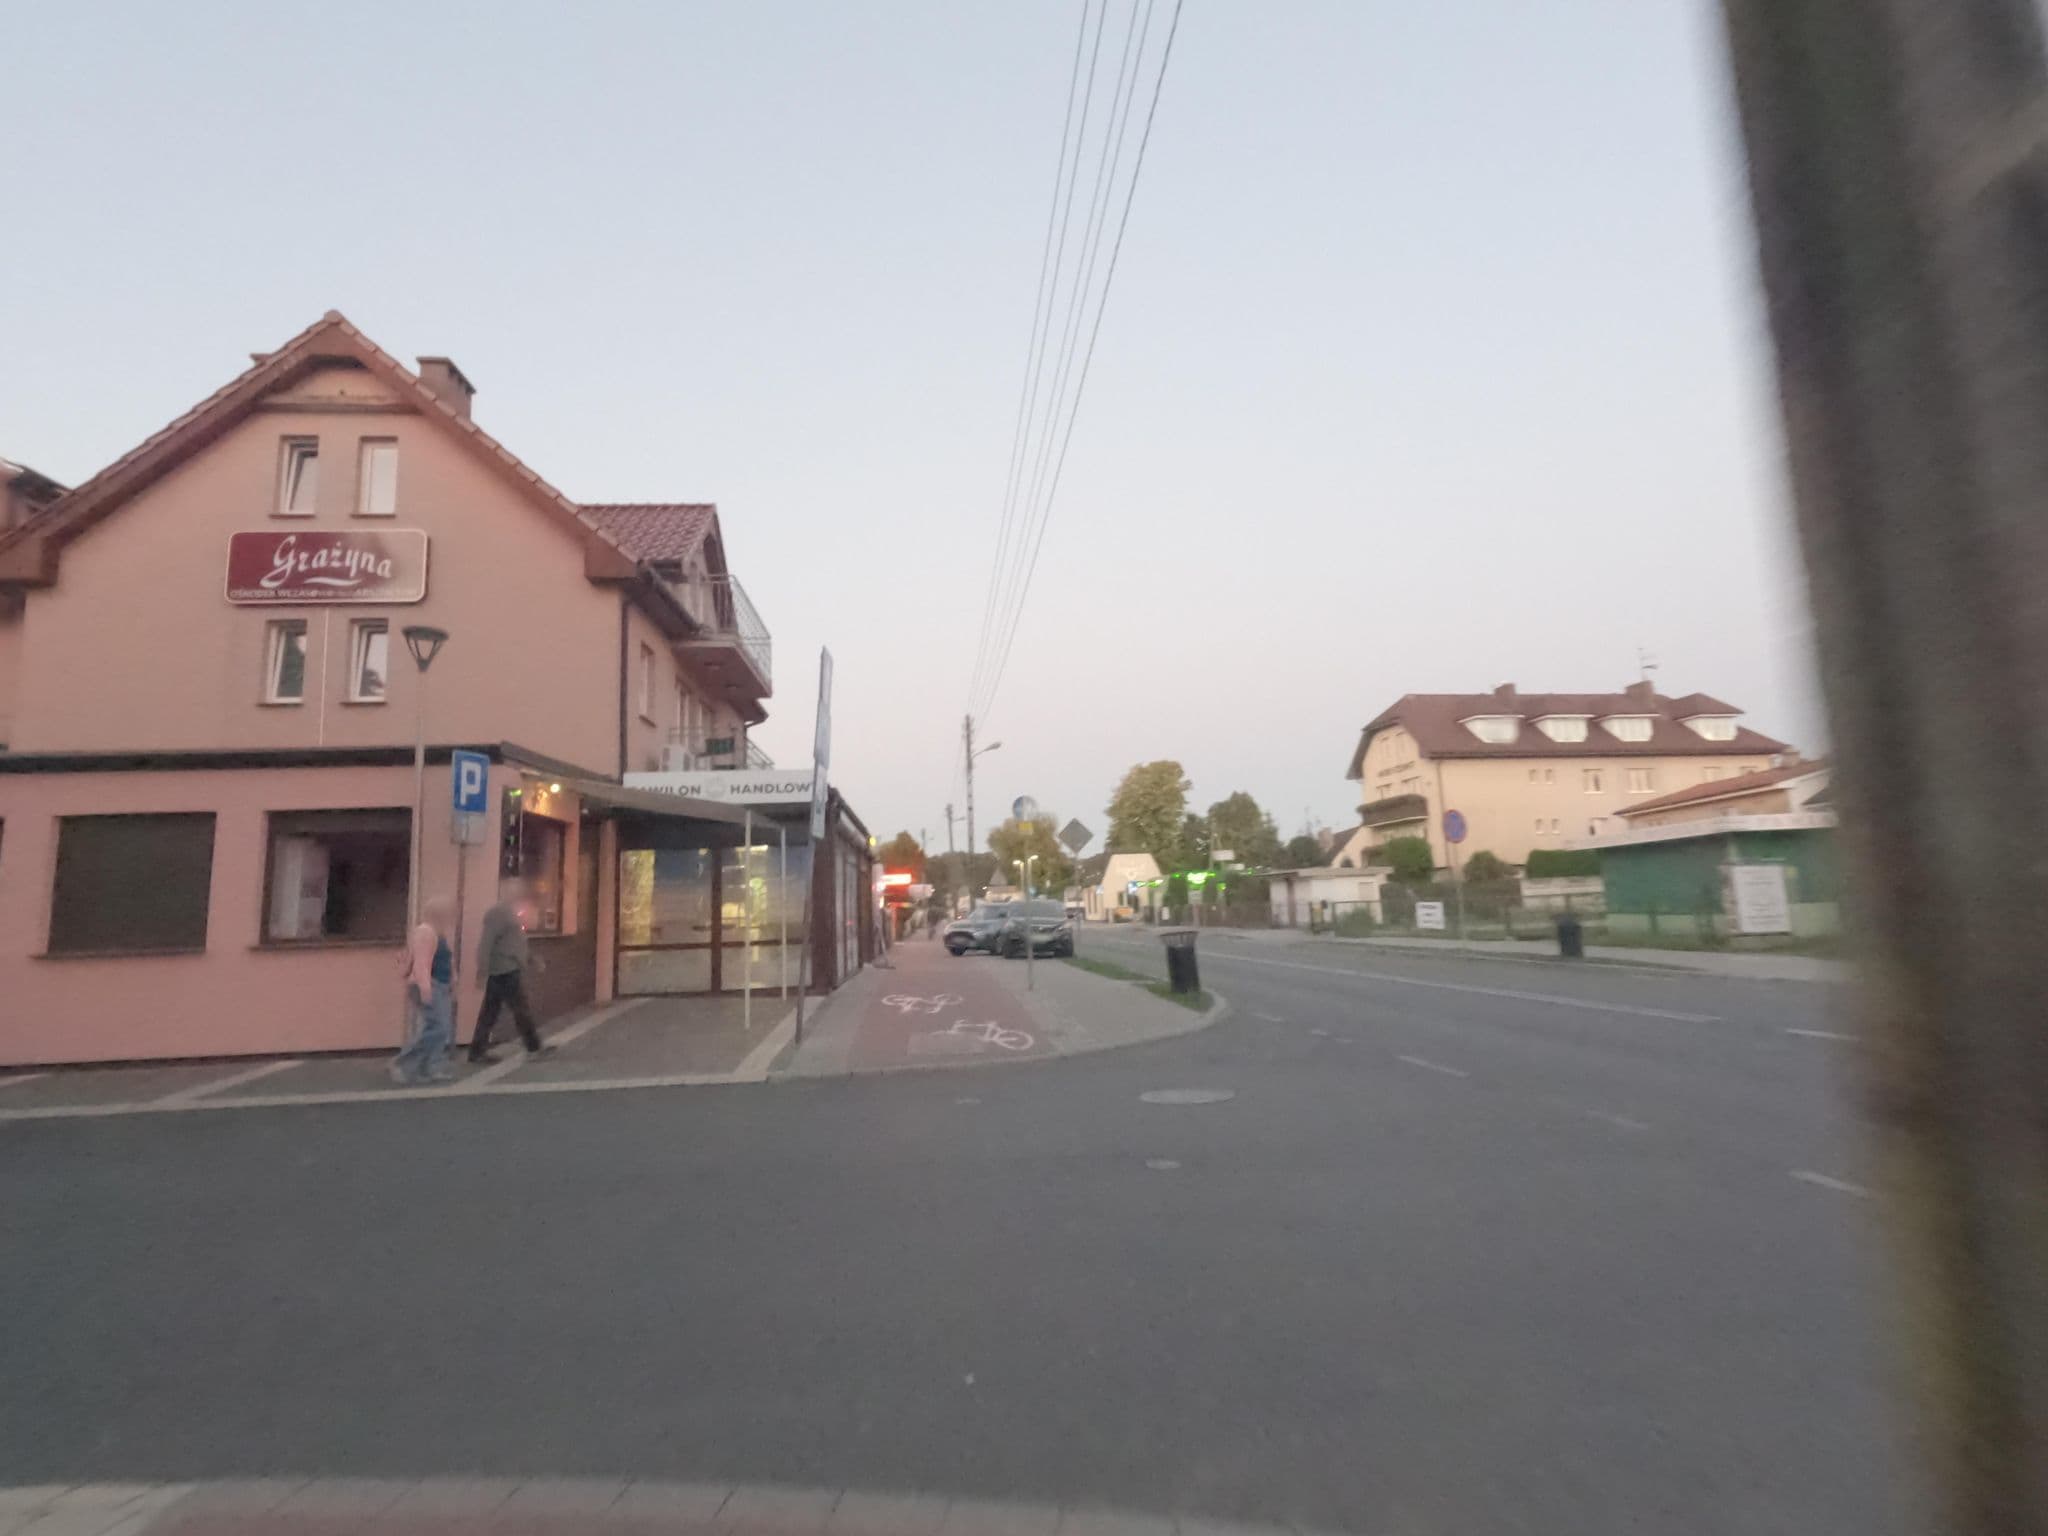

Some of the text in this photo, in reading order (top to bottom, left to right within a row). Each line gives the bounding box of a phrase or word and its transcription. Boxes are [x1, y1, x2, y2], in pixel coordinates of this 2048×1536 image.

[259, 535, 393, 588] Grażyna
[461, 761, 481, 805] P
[633, 783, 813, 796] AWILON HANDLOW
